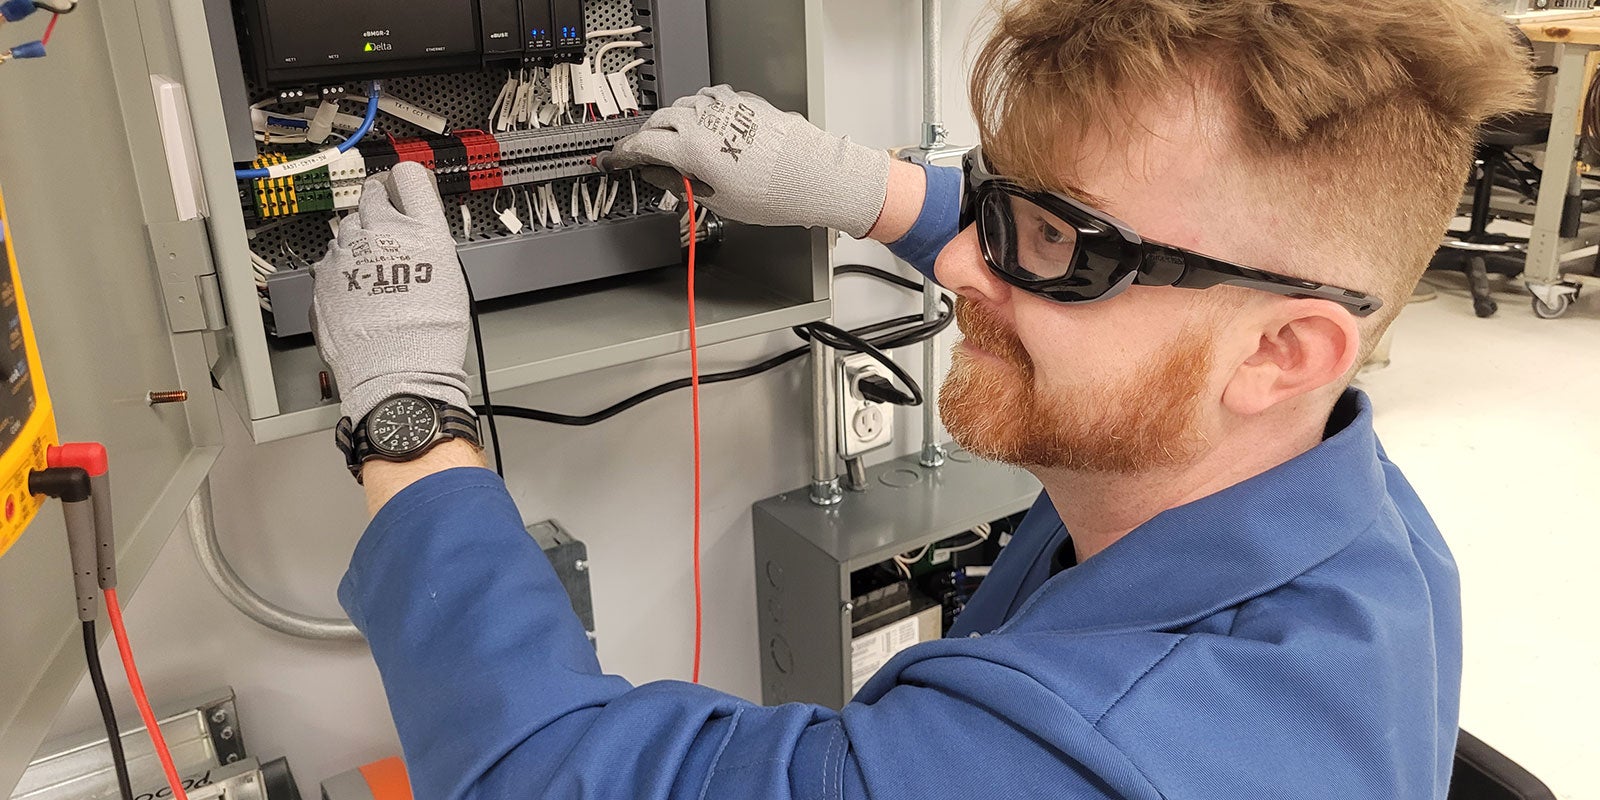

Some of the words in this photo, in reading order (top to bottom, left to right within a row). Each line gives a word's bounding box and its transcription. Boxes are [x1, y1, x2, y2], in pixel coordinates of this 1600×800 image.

[371, 42, 392, 51] Delta
[720, 103, 755, 162] CUT-X
[342, 262, 433, 292] CUT-X
